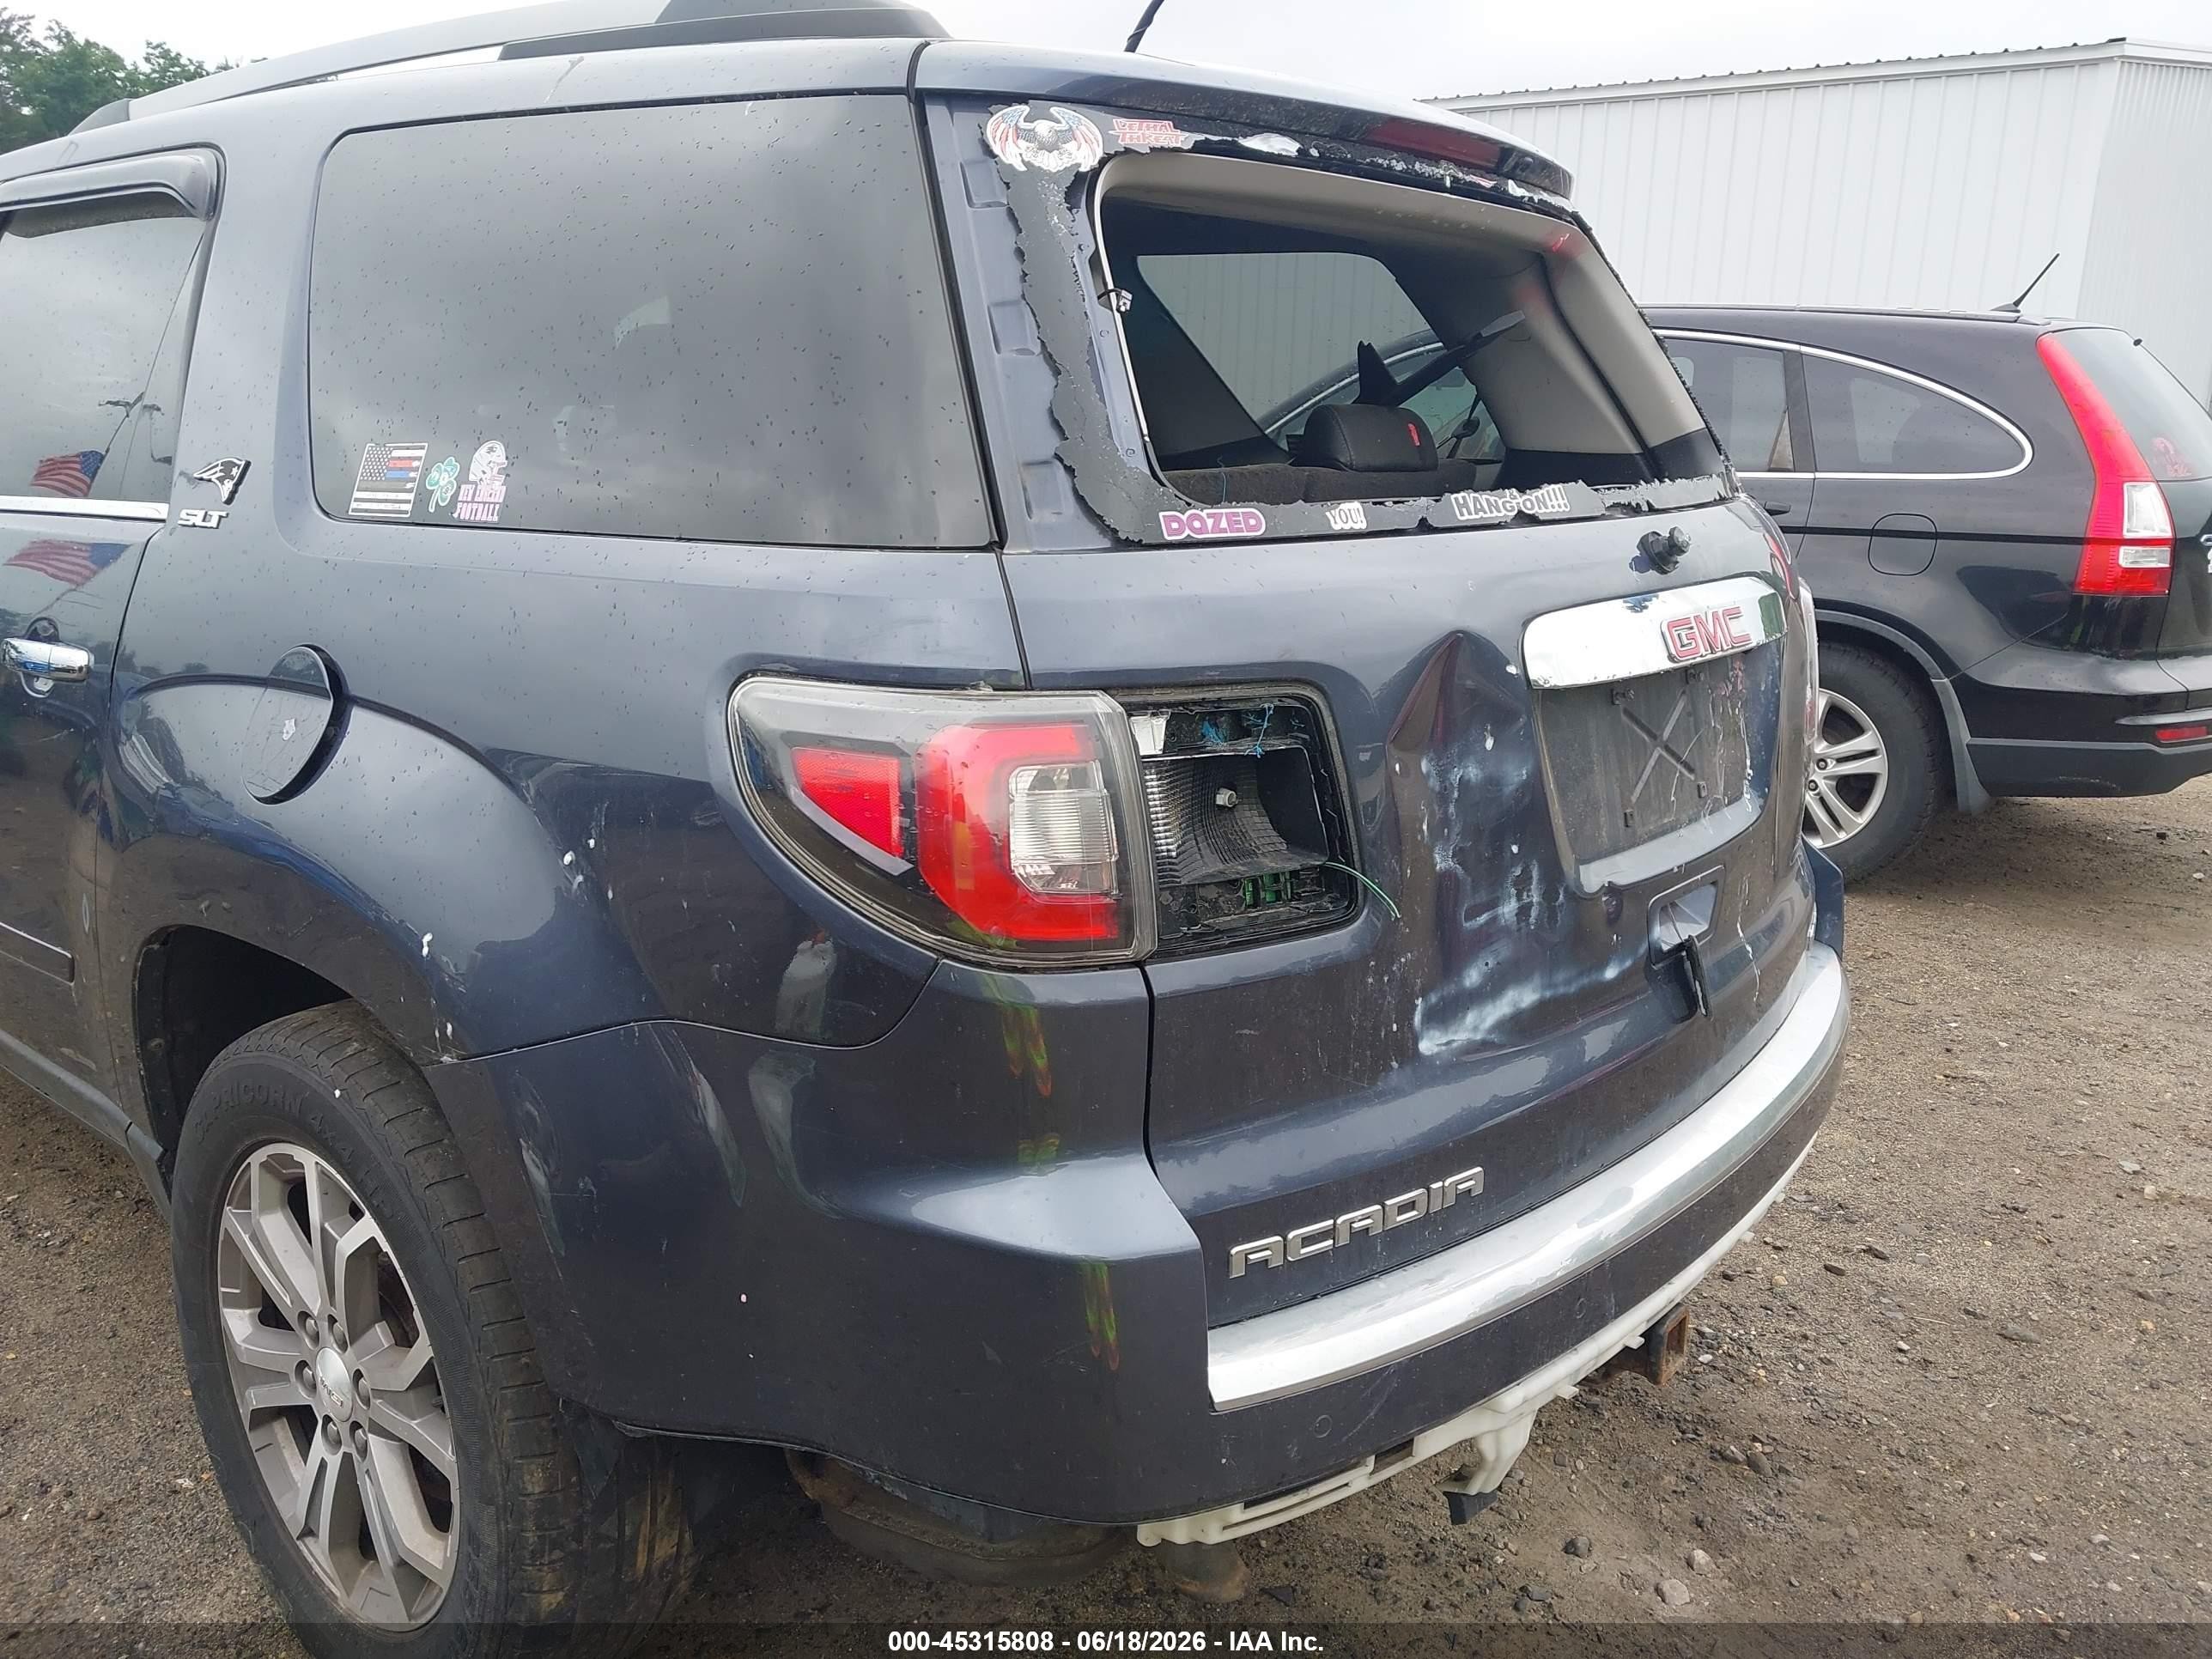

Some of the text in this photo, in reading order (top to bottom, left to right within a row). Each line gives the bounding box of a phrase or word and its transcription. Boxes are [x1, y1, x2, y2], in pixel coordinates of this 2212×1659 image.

[1113, 118, 1180, 133] LETHAL
[1118, 131, 1184, 146] THREAT
[455, 501, 501, 522] FOOTBALL
[1328, 505, 1366, 527] YOU!
[1451, 493, 1518, 520] HANG
[177, 508, 229, 530] SLT
[1663, 605, 1753, 661] GMC
[1228, 1165, 1486, 1280] ACADIA
